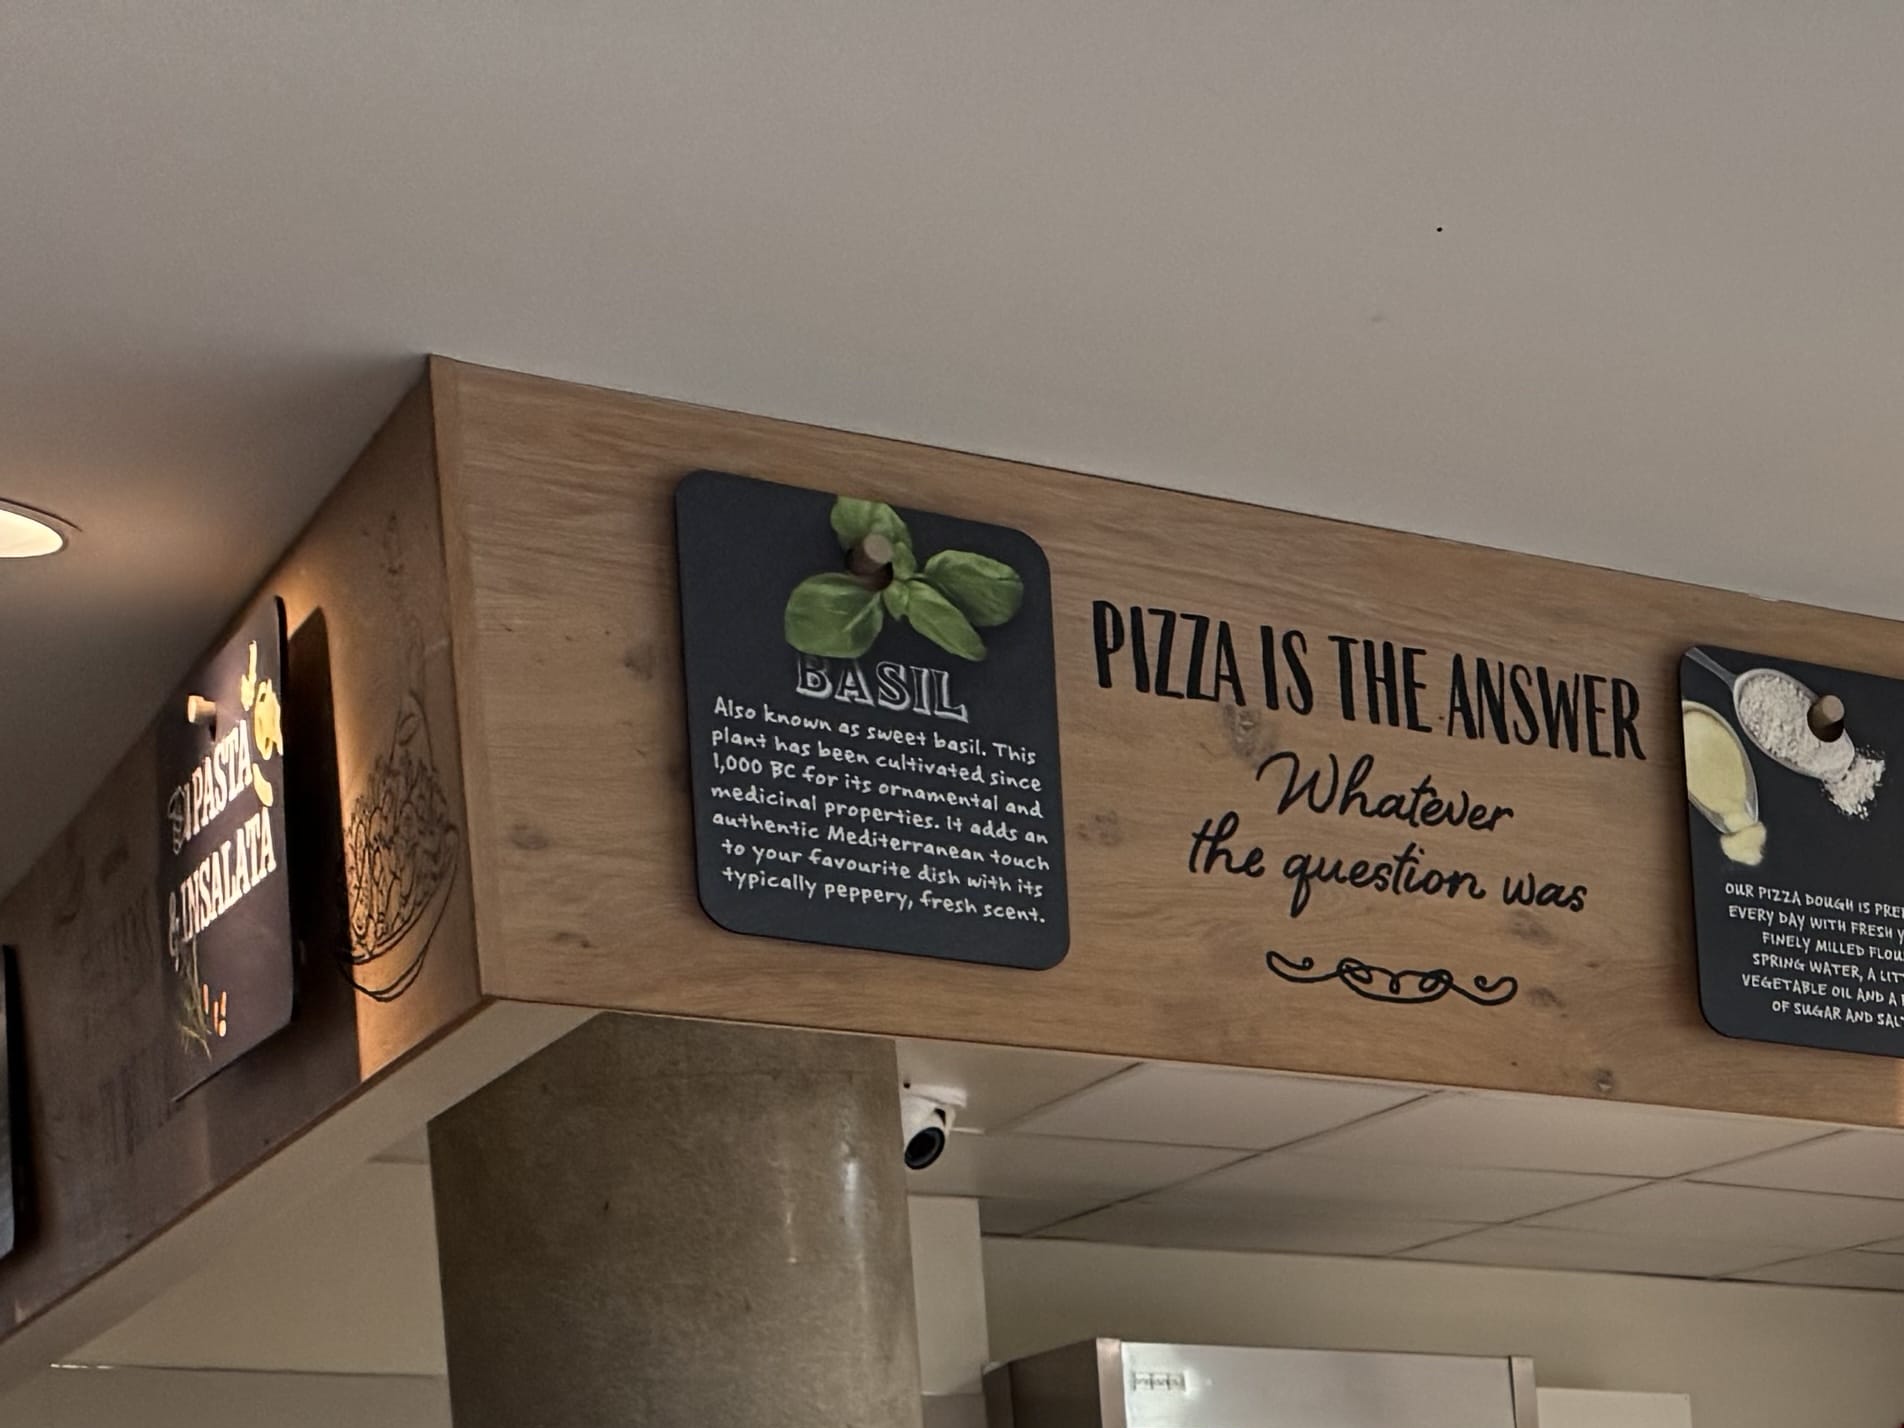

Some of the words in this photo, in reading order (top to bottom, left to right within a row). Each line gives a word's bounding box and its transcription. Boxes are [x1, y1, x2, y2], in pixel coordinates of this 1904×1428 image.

[796, 656, 968, 723] BASIL
[1092, 600, 1246, 707] PIZZA
[1260, 624, 1314, 715] IS
[1328, 636, 1433, 734] THE
[1448, 652, 1646, 760] ANSWER
[712, 728, 766, 748] plant
[774, 736, 810, 757] has
[818, 741, 869, 765] been
[876, 754, 984, 784] cultivated
[990, 770, 1042, 791] since
[714, 697, 756, 720] Also
[764, 704, 832, 732] known
[839, 722, 859, 737] as
[867, 726, 926, 746] sweet
[934, 732, 987, 757] basil.
[993, 742, 1036, 765] This
[711, 785, 817, 811] medicinal
[825, 798, 939, 830] properties.
[947, 817, 962, 832] It
[970, 820, 1017, 842] adds
[1025, 830, 1048, 844] an
[713, 752, 762, 775] 1,000
[770, 760, 796, 779] BC
[802, 767, 839, 787] for
[845, 774, 872, 793] its
[879, 782, 998, 811] ornamental
[1006, 800, 1043, 819] and
[1256, 752, 1513, 831] Whatever
[713, 812, 819, 839] authentic
[828, 826, 984, 862] Mediterranean
[991, 850, 1050, 871] touch
[721, 839, 745, 856] to
[753, 843, 802, 865] your
[808, 848, 911, 879] favourite
[918, 866, 961, 886] dish
[968, 874, 1011, 893] with
[1018, 879, 1043, 898] its
[1188, 812, 1266, 878] the
[1283, 842, 1486, 918] question
[1504, 872, 1588, 912] was
[180, 807, 277, 944] INSALATA
[722, 867, 817, 898] typically
[825, 881, 913, 911] peppery,
[920, 890, 977, 914] fresh
[983, 902, 1045, 923] scent.
[1725, 882, 1754, 899] OUR
[1758, 886, 1802, 906] PIZZA
[1805, 893, 1853, 912] DOUGH
[1858, 901, 1870, 914] IS
[1728, 905, 1774, 927] EVERY
[1779, 911, 1805, 932] DAY
[1810, 916, 1846, 933] WITH
[1851, 921, 1893, 939] FRESH
[1762, 932, 1811, 954] FINELY
[1815, 939, 1865, 956] MILLED
[1742, 973, 1827, 996] VEGETABLE
[1831, 985, 1852, 999] OIL
[1857, 988, 1884, 1003] AND
[1889, 992, 1897, 1007] A
[1752, 953, 1805, 972] SPRING
[1809, 960, 1863, 983] WATER,
[1867, 967, 1876, 981] A
[1772, 1000, 1790, 1012] OF
[1794, 1002, 1842, 1020] SUGAR
[1845, 1010, 1873, 1024] AND
